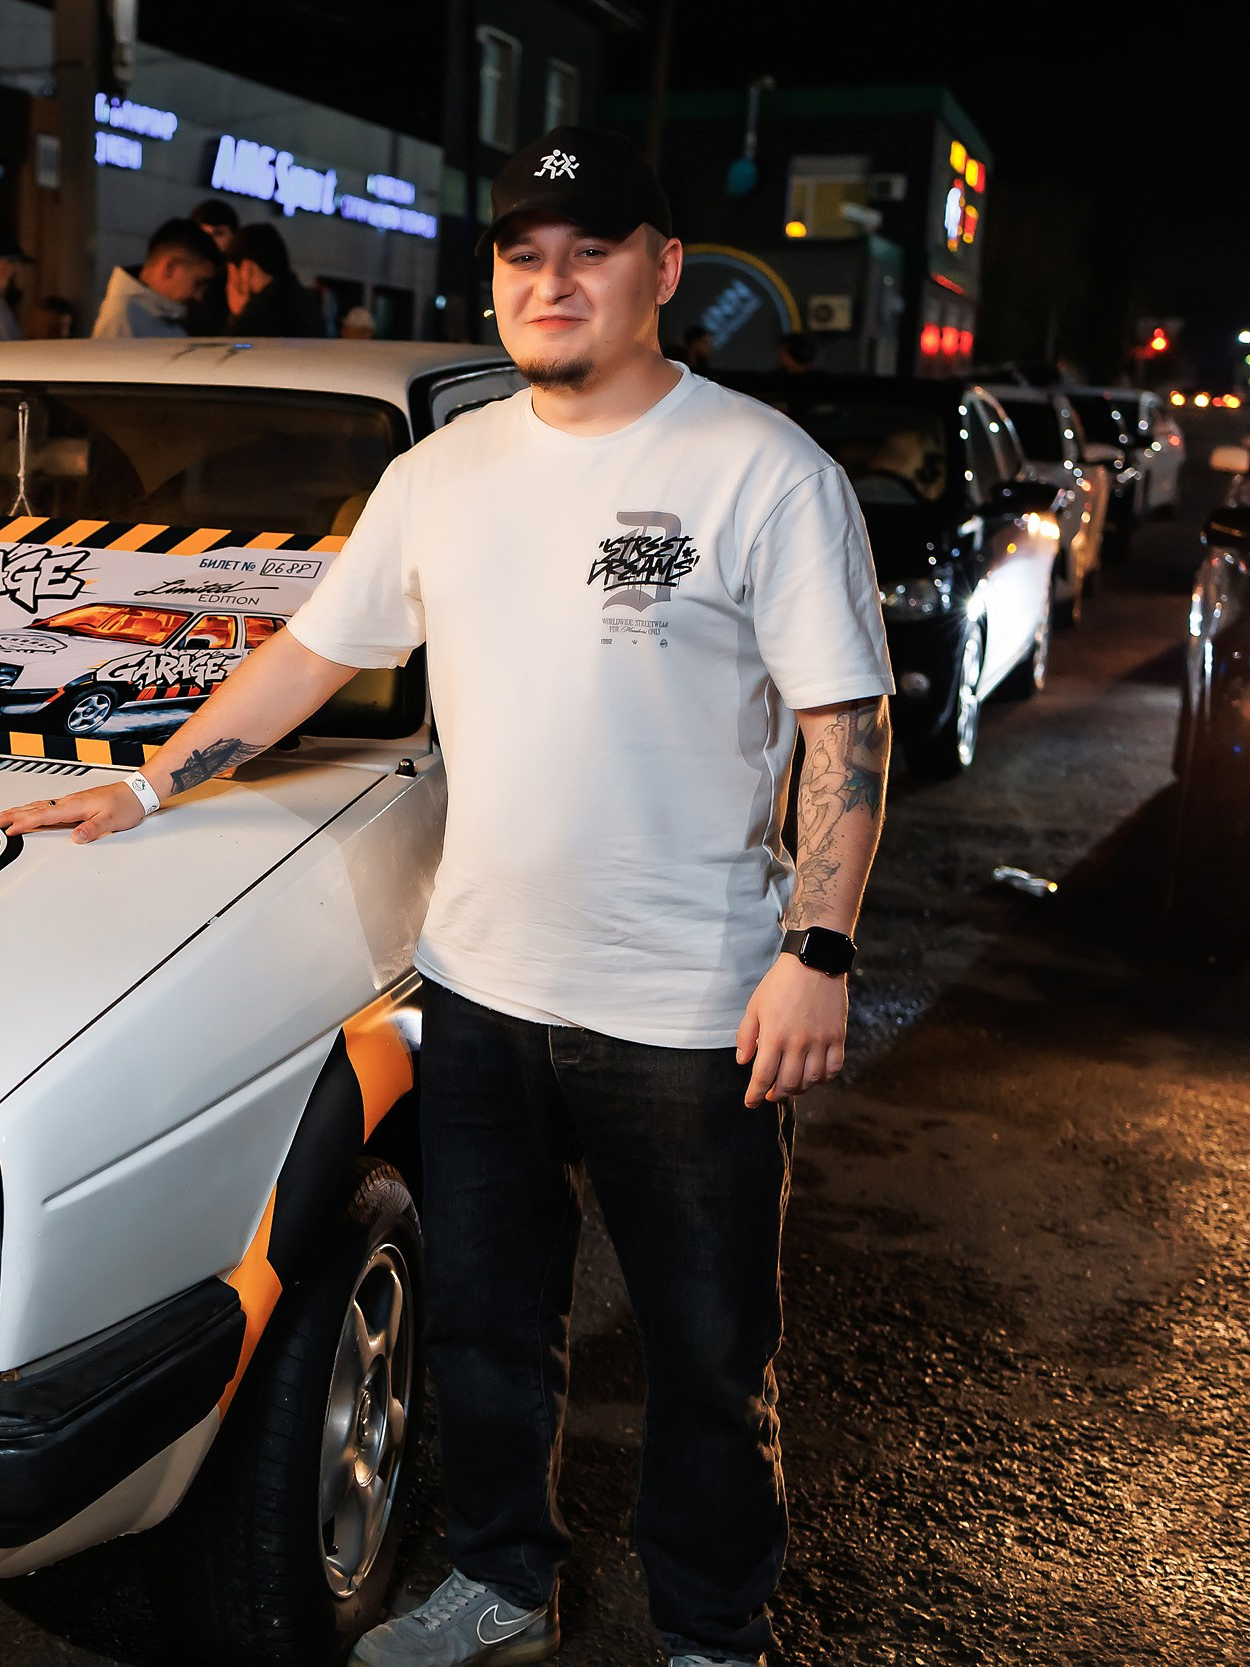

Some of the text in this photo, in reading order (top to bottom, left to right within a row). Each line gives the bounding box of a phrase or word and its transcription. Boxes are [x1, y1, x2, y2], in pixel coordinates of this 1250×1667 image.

[199, 558, 240, 571] БИЛЕТ
[134, 579, 280, 596] Limited
[198, 594, 260, 606] EDITION
[634, 619, 669, 628] STREETWEAR
[96, 650, 232, 688] GARAGE
